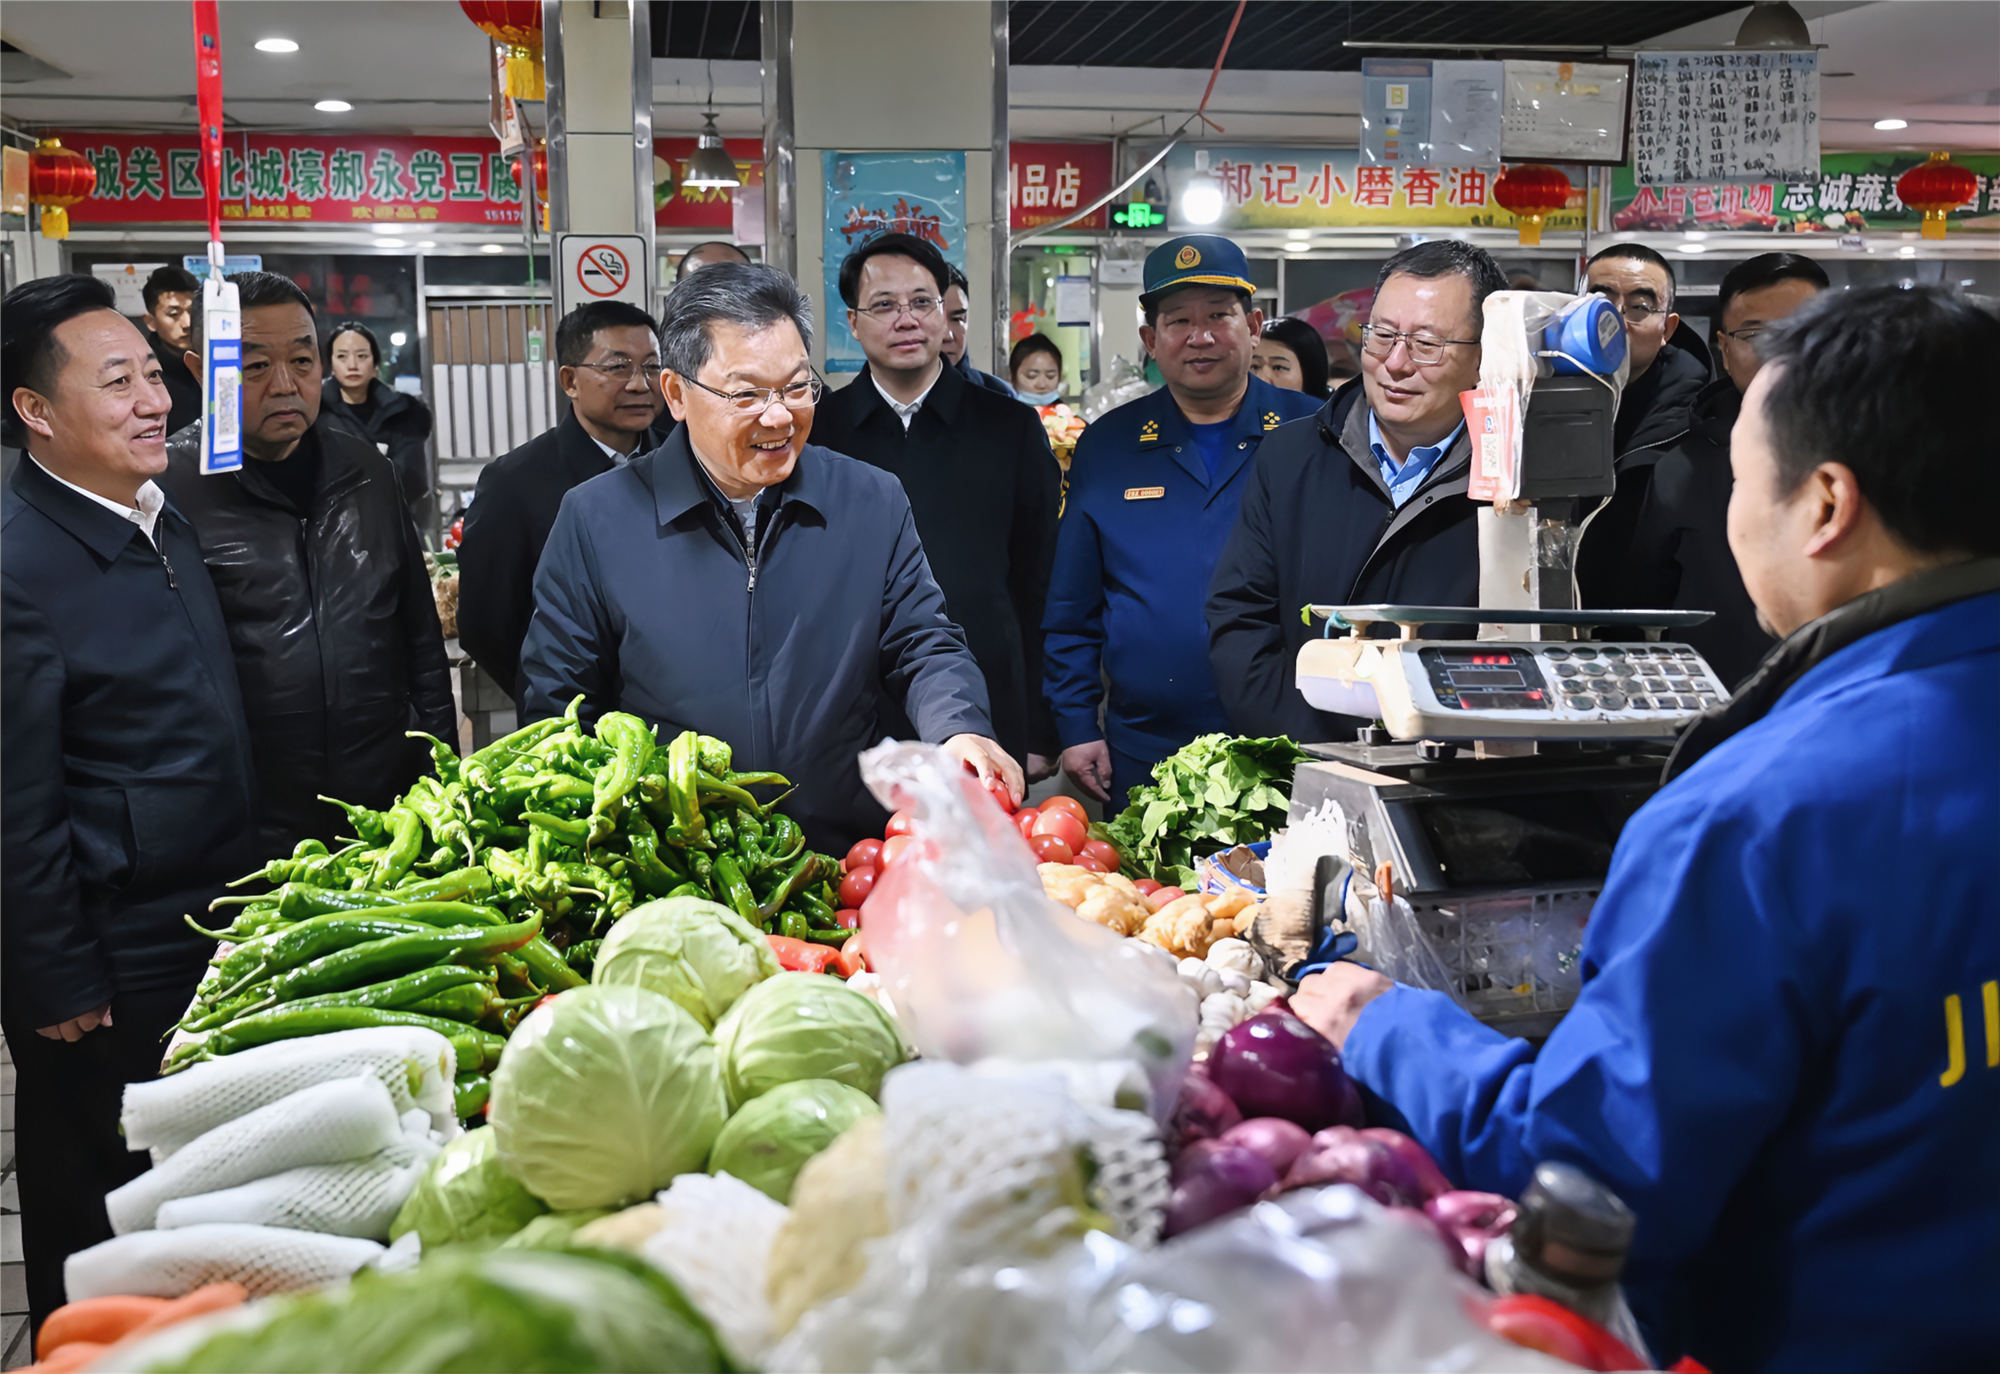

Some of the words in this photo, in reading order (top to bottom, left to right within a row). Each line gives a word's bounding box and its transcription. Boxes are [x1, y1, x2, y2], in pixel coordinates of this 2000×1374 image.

[1213, 161, 1488, 208] 郝记小磨香油
